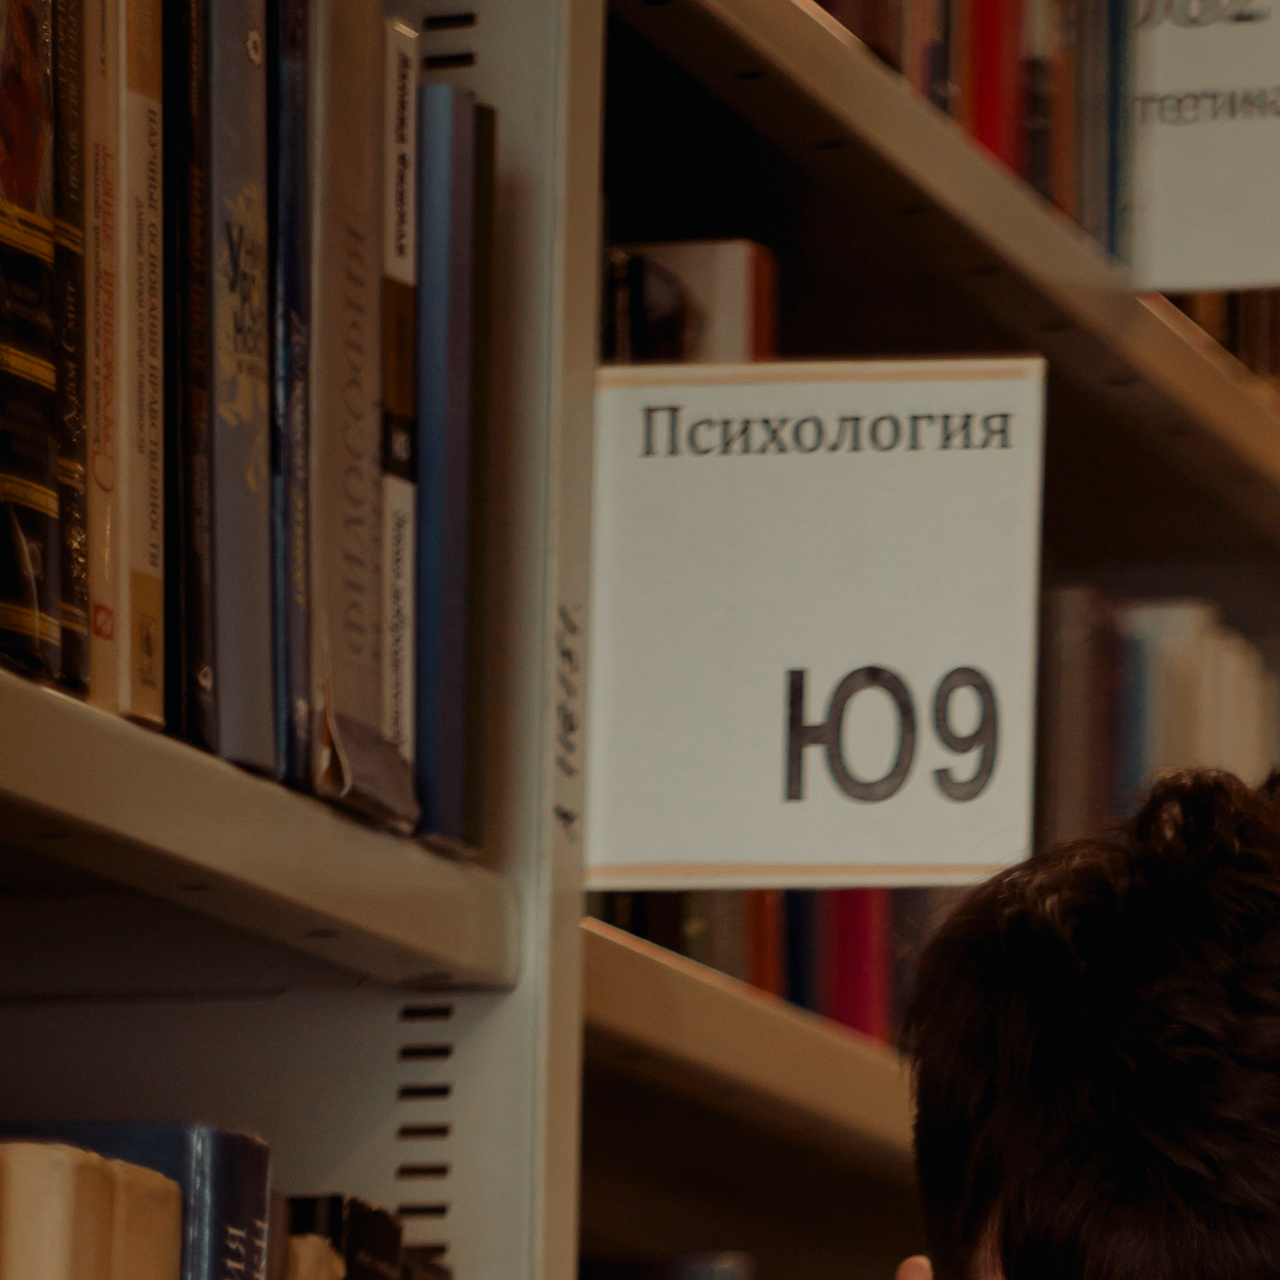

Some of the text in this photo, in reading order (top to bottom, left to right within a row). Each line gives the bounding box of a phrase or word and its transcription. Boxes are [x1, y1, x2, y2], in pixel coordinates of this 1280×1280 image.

[148, 108, 159, 568] НАУЧНЫЕ ОСНОВАНИЯ НРАВСТВЕННОСТИ
[641, 405, 1015, 458] Психология
[784, 664, 999, 803] Ю9
